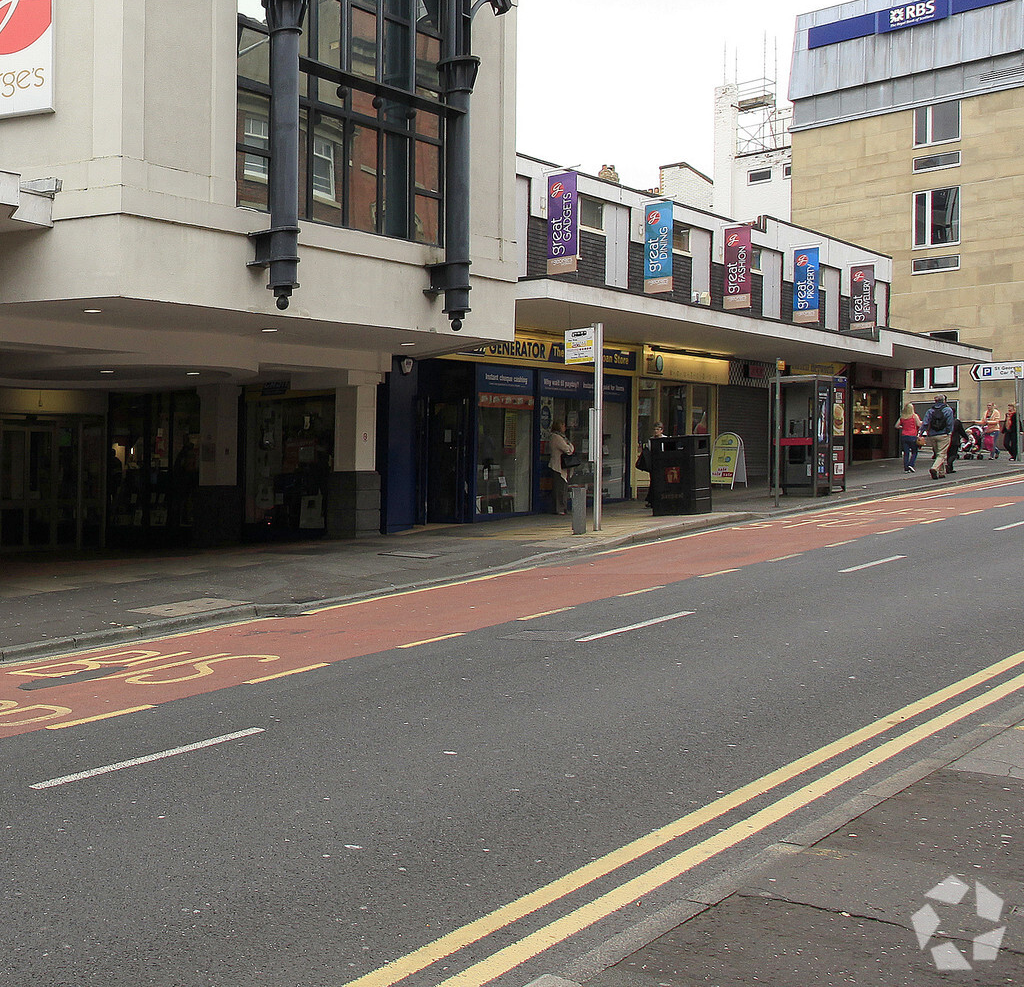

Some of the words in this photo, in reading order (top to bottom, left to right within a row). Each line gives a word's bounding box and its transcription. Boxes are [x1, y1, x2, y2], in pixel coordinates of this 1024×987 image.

[905, 0, 936, 20] RBS
[562, 192, 572, 242] GADGETS
[550, 217, 566, 256] great
[659, 226, 669, 260] DINING
[647, 237, 662, 272] great
[737, 245, 747, 283] FASHION
[727, 261, 740, 294] great
[796, 279, 809, 310] great
[806, 263, 816, 299] PROPERTY
[853, 294, 866, 322] great
[862, 278, 871, 314] JEWELLERY
[489, 340, 546, 359] GENERATOR
[553, 346, 564, 358] The
[613, 353, 629, 365] Store
[485, 373, 499, 381] Instant
[513, 376, 528, 385] cashing
